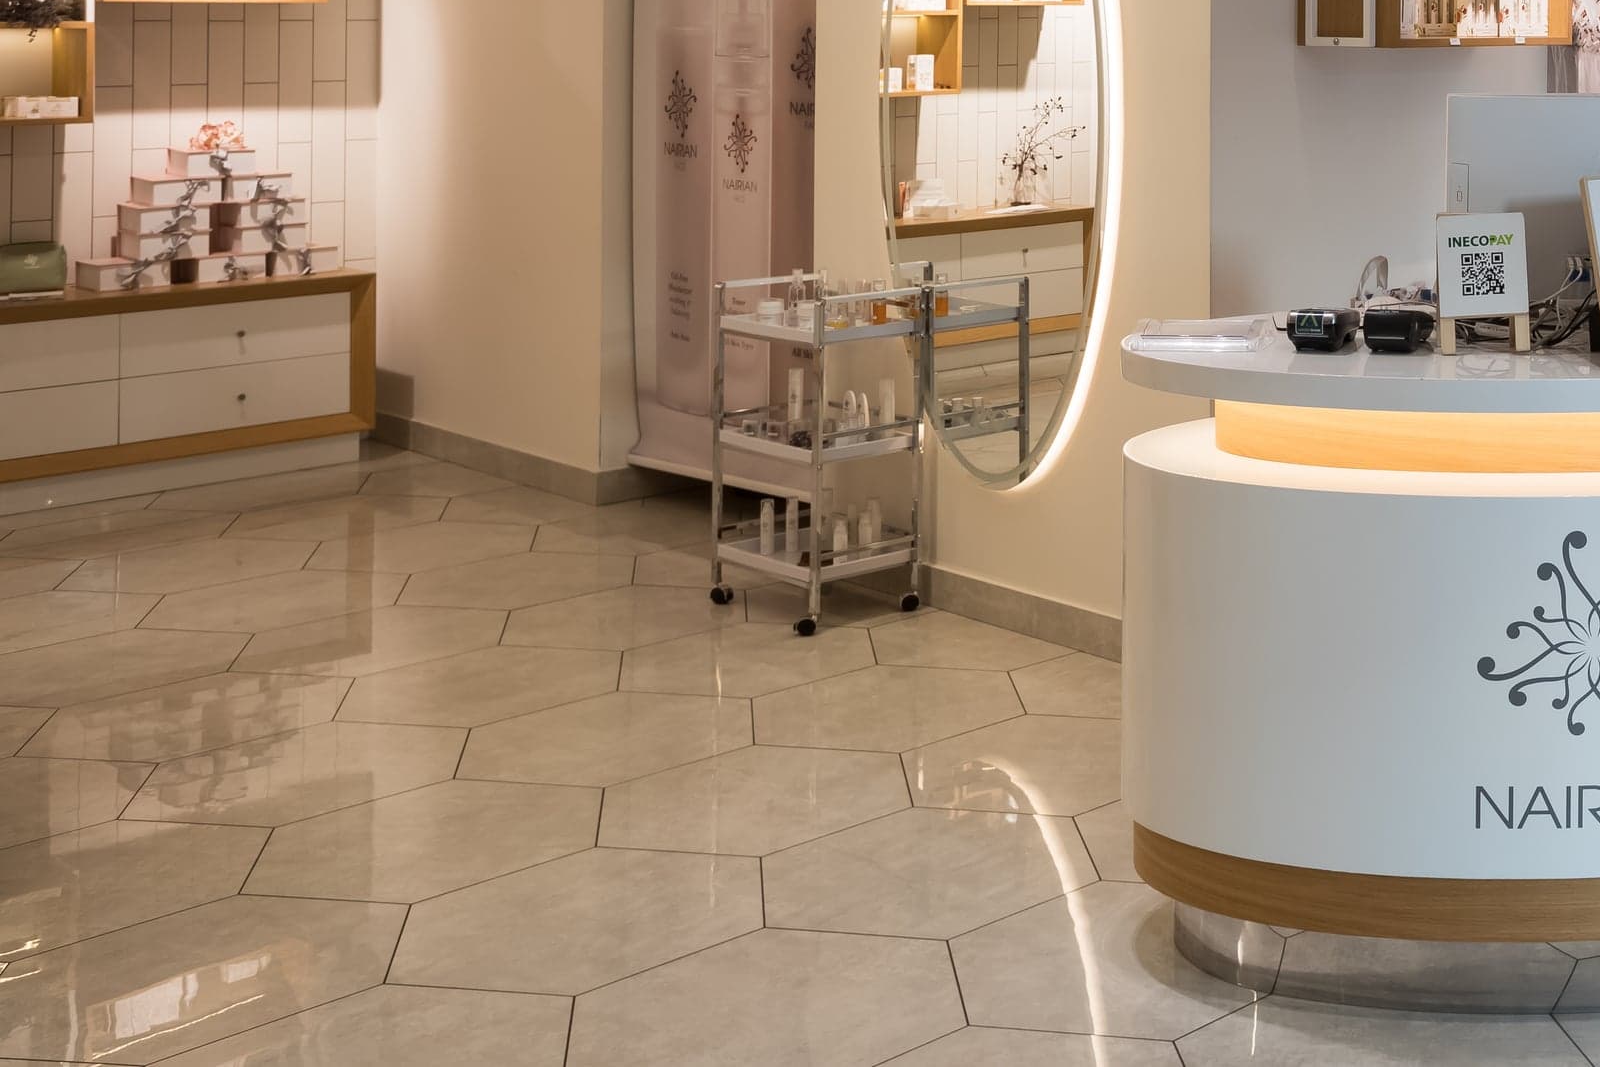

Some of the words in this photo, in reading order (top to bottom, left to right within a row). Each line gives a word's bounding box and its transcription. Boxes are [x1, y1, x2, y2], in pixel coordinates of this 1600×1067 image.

[663, 141, 698, 158] NAIRIAN
[722, 178, 758, 193] NAIRIAN
[1448, 233, 1514, 248] INECOPAY
